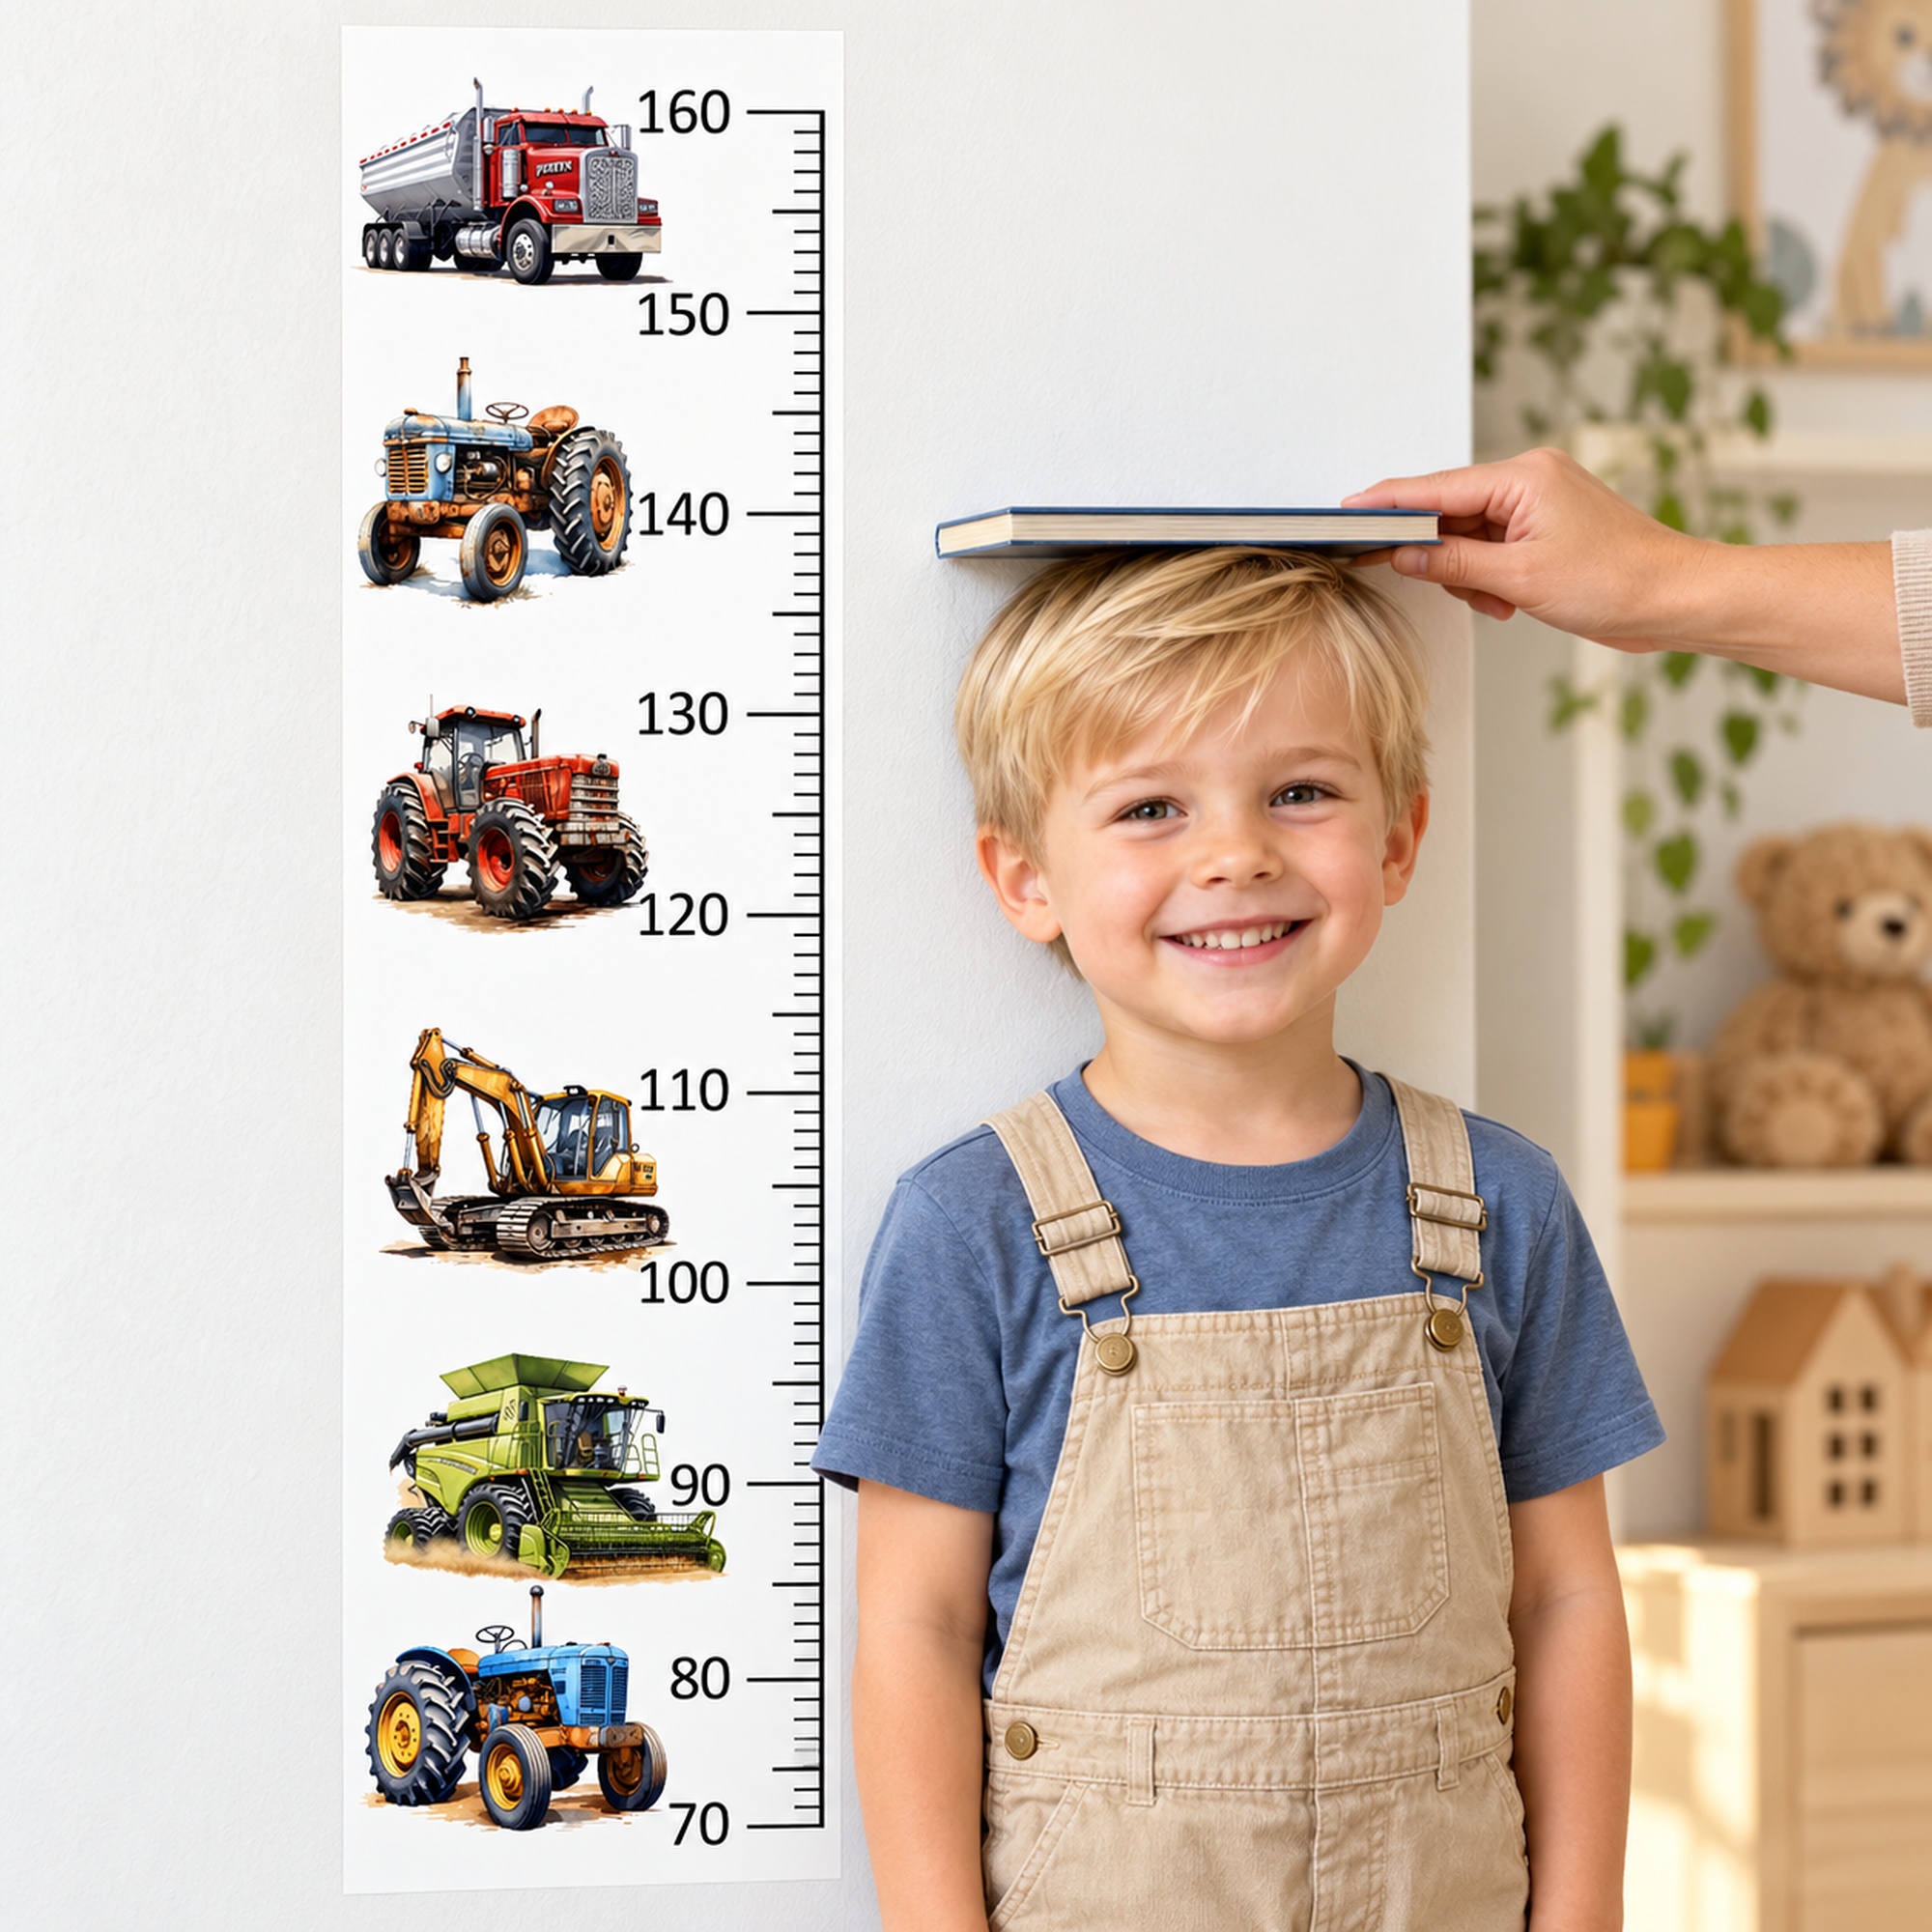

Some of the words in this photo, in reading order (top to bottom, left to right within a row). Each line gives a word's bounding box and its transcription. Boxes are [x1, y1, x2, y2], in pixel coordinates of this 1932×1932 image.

[638, 89, 730, 134] 160
[638, 292, 729, 336] 150
[638, 492, 729, 536] 140
[638, 691, 729, 736] 130
[638, 892, 729, 937] 120
[639, 1067, 729, 1112] 110
[639, 1261, 729, 1304] 100
[669, 1463, 730, 1507] 90
[669, 1656, 730, 1700] 80
[668, 1802, 729, 1846] 70
